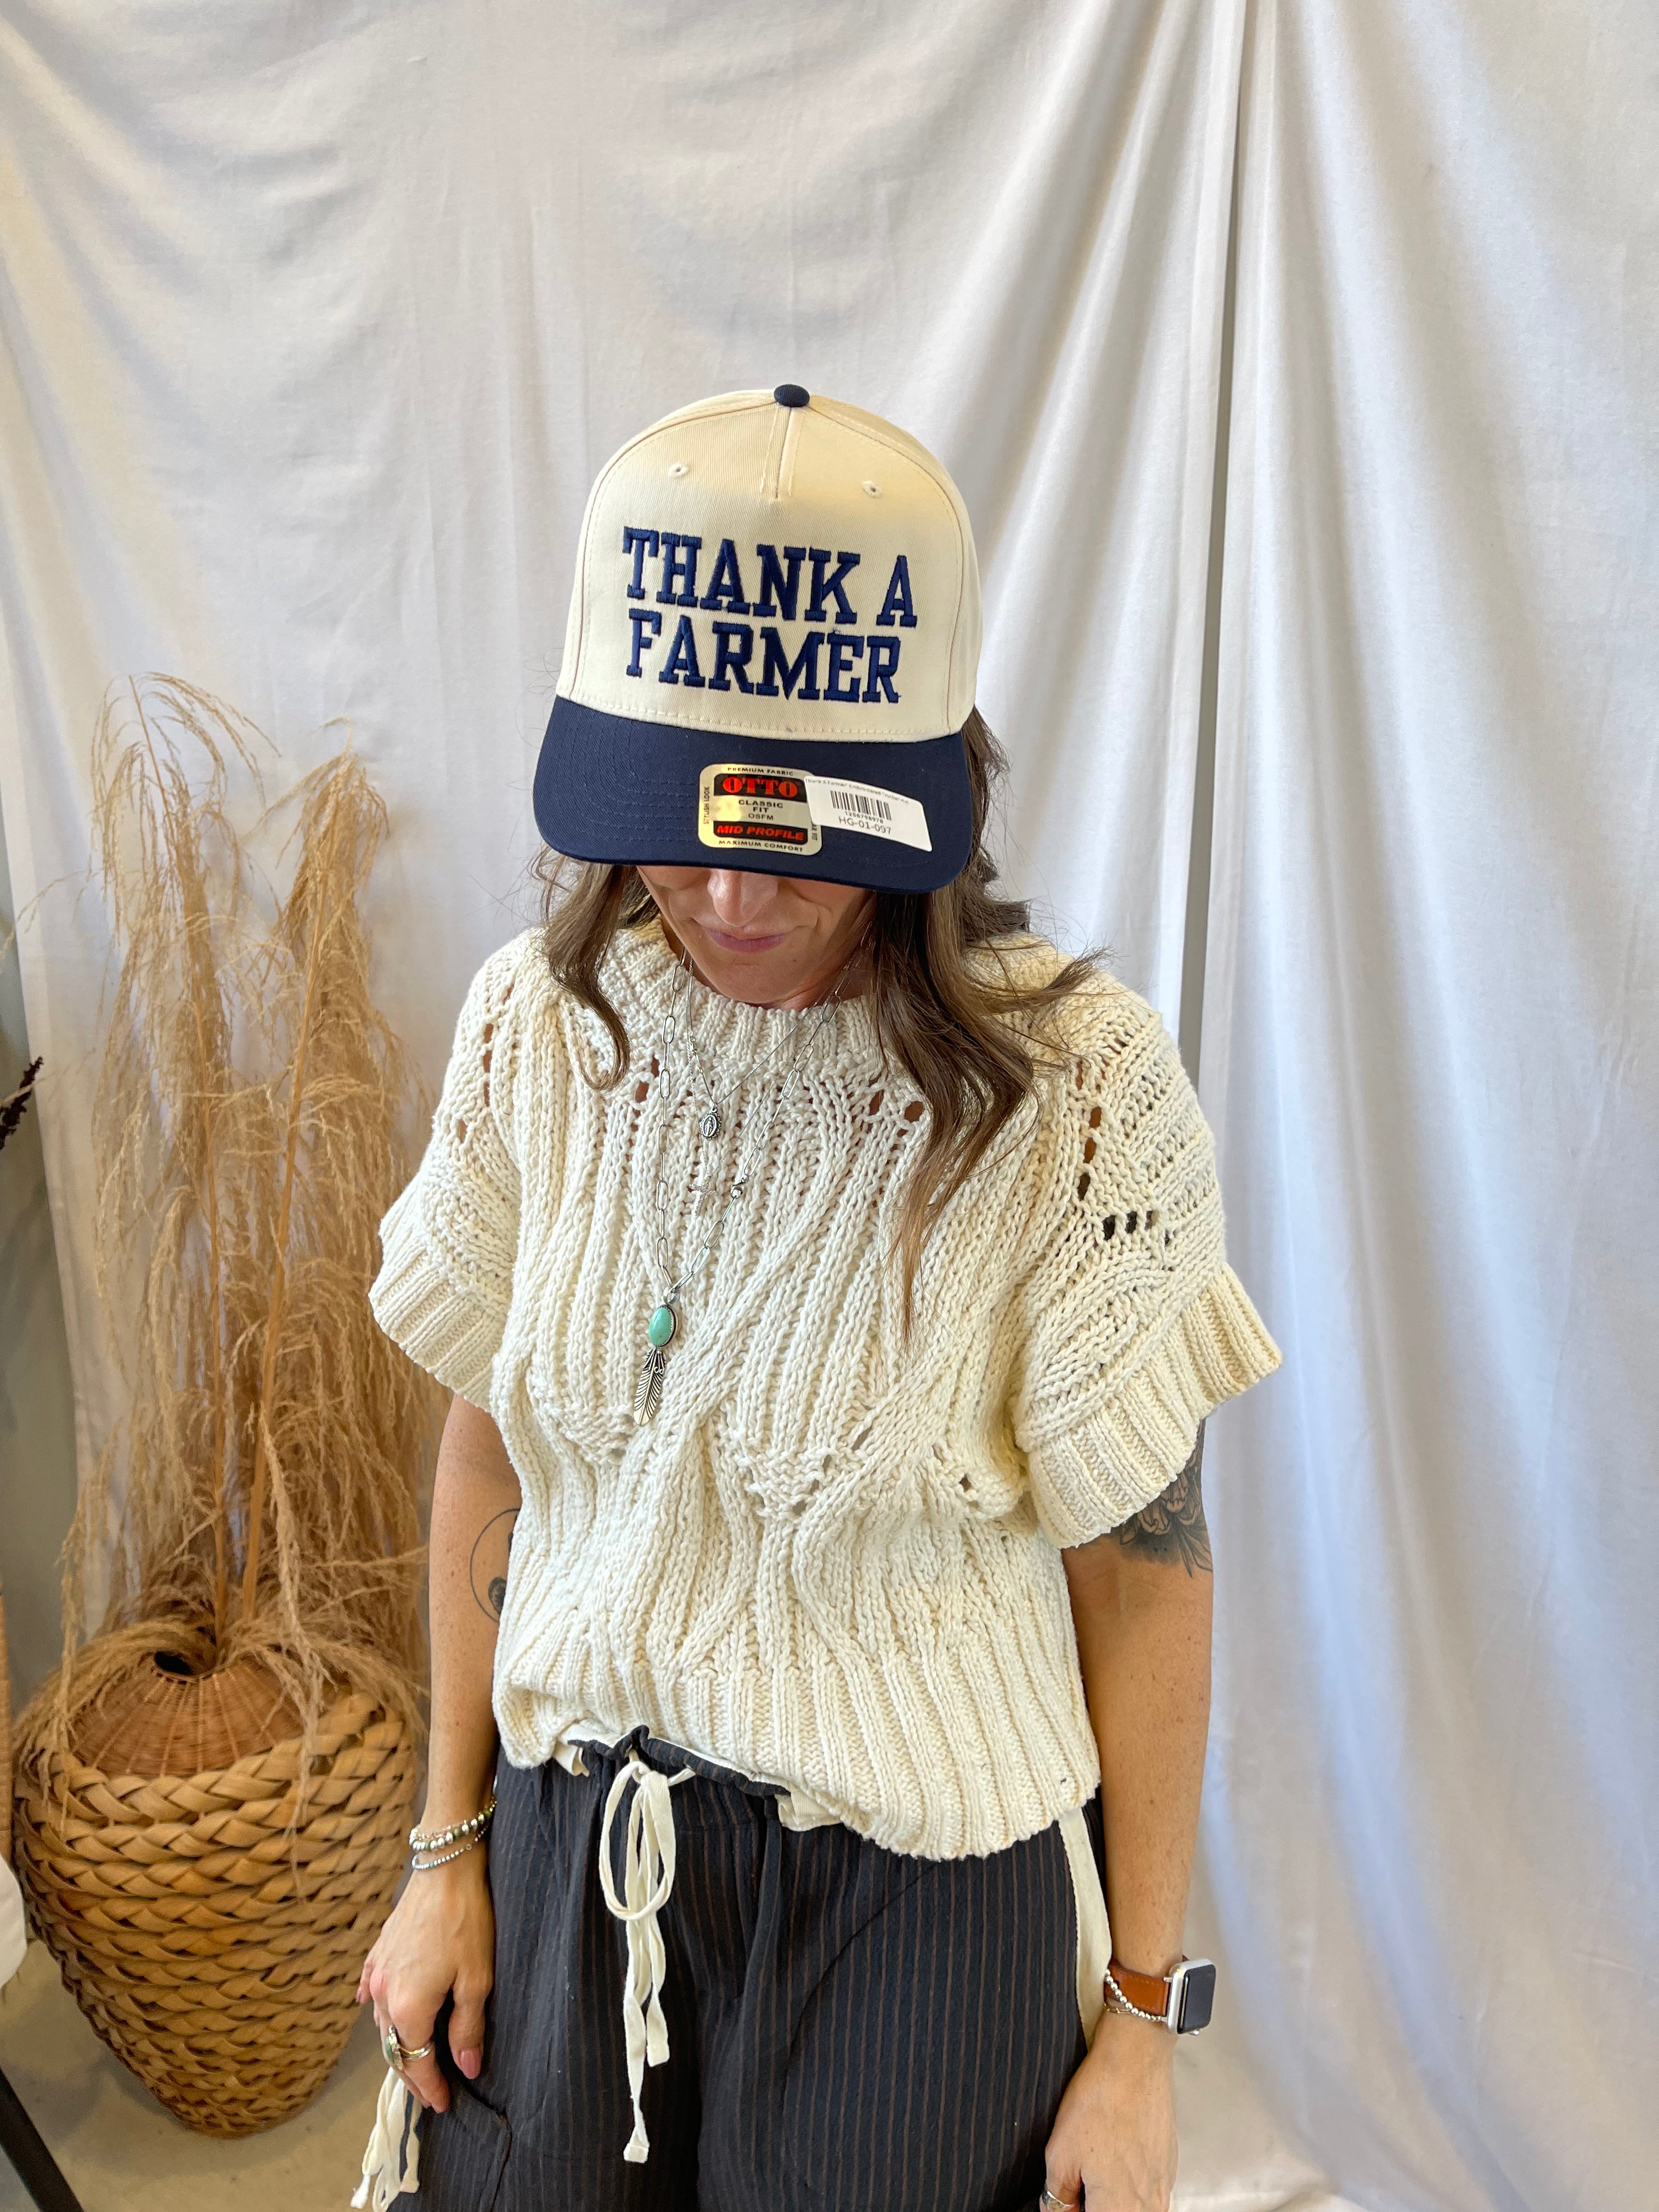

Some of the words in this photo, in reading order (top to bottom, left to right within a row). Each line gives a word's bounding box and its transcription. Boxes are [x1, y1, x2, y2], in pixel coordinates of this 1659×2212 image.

[622, 526, 860, 624] THANK
[876, 555, 917, 628] A
[626, 608, 901, 703] FARMER
[723, 776, 798, 798] OTTO
[738, 799, 783, 809] CLASSIC
[716, 825, 743, 834] MID
[746, 826, 804, 840] PROFILE
[838, 816, 891, 834] HG-01-097
[764, 843, 803, 853] COMFORT
